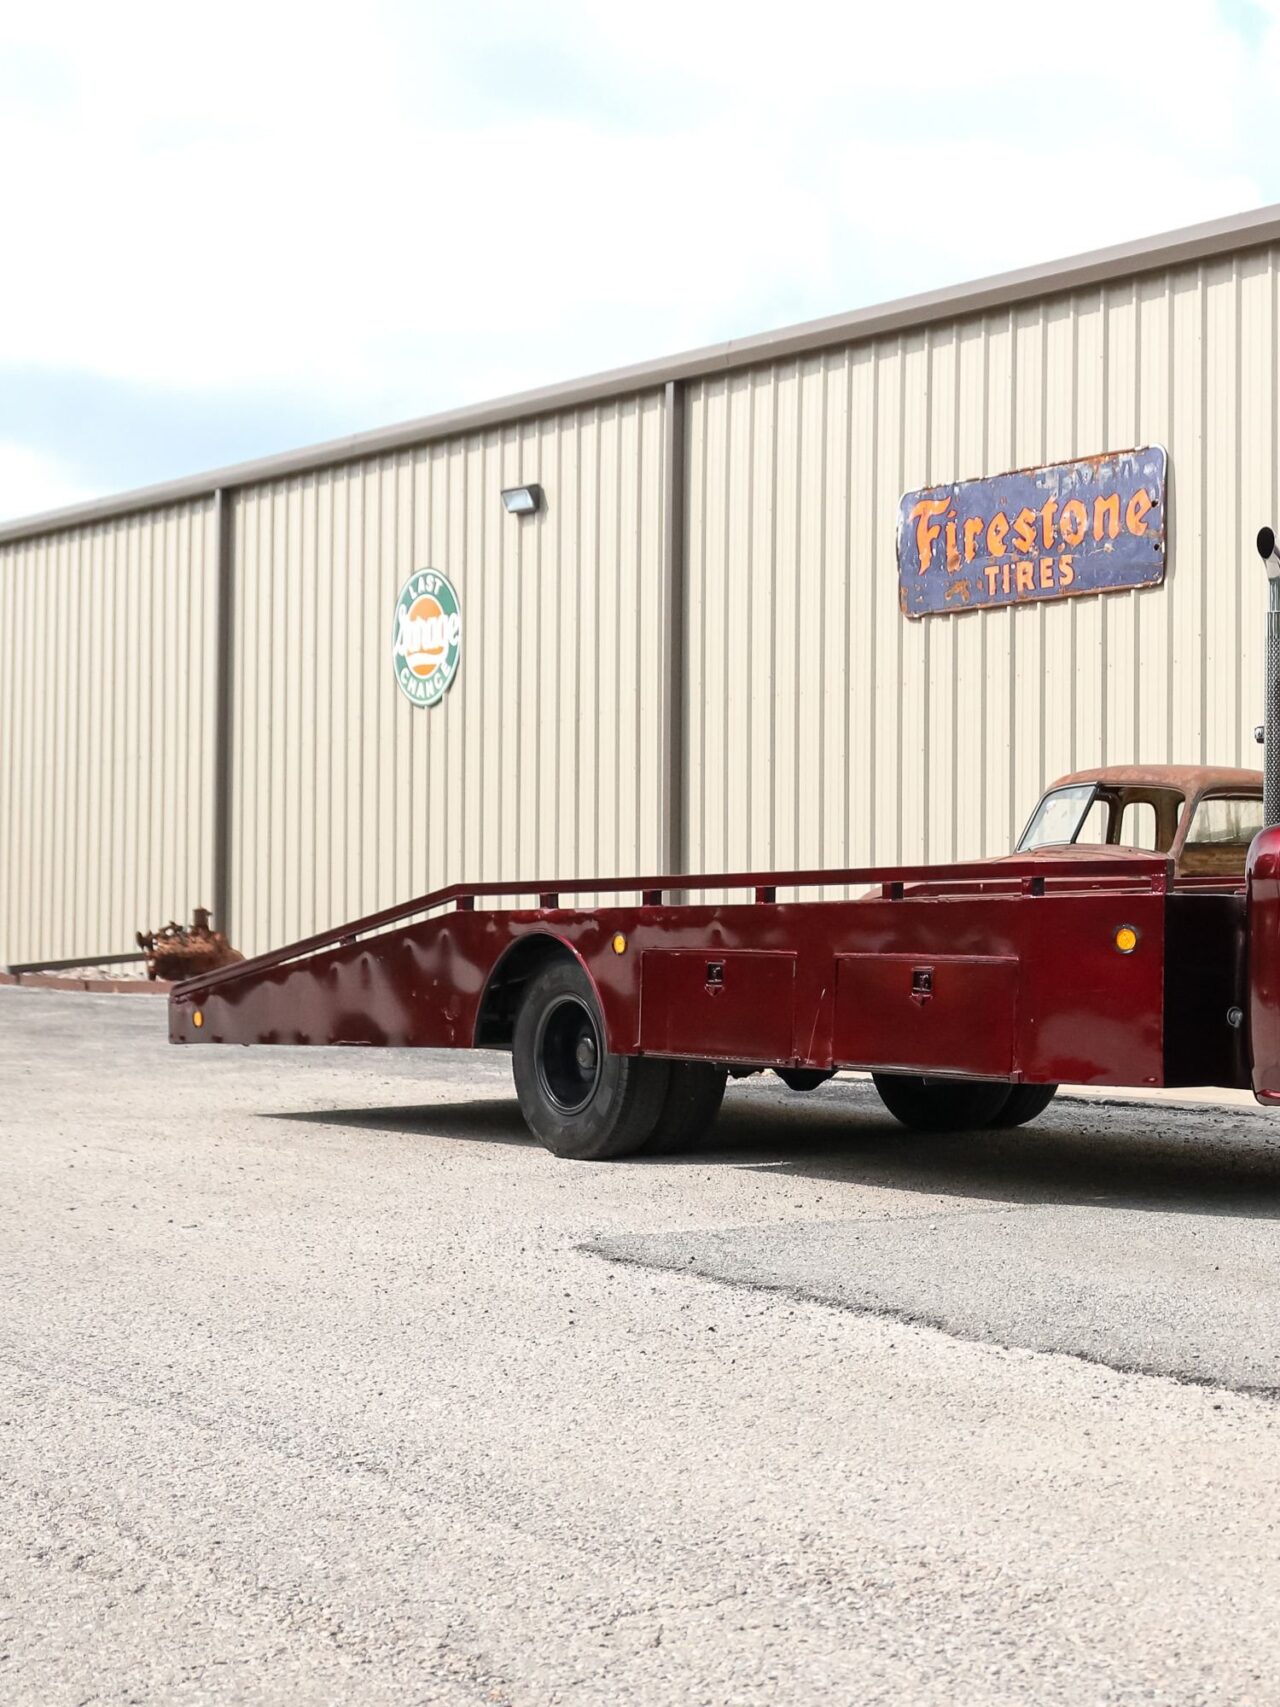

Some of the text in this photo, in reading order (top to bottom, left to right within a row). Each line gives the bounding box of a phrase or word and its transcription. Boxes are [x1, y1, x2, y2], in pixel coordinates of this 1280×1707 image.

[911, 488, 1154, 575] Firestone
[408, 575, 442, 599] LAST
[983, 554, 1075, 596] TIRES
[400, 661, 451, 698] CHANCE
